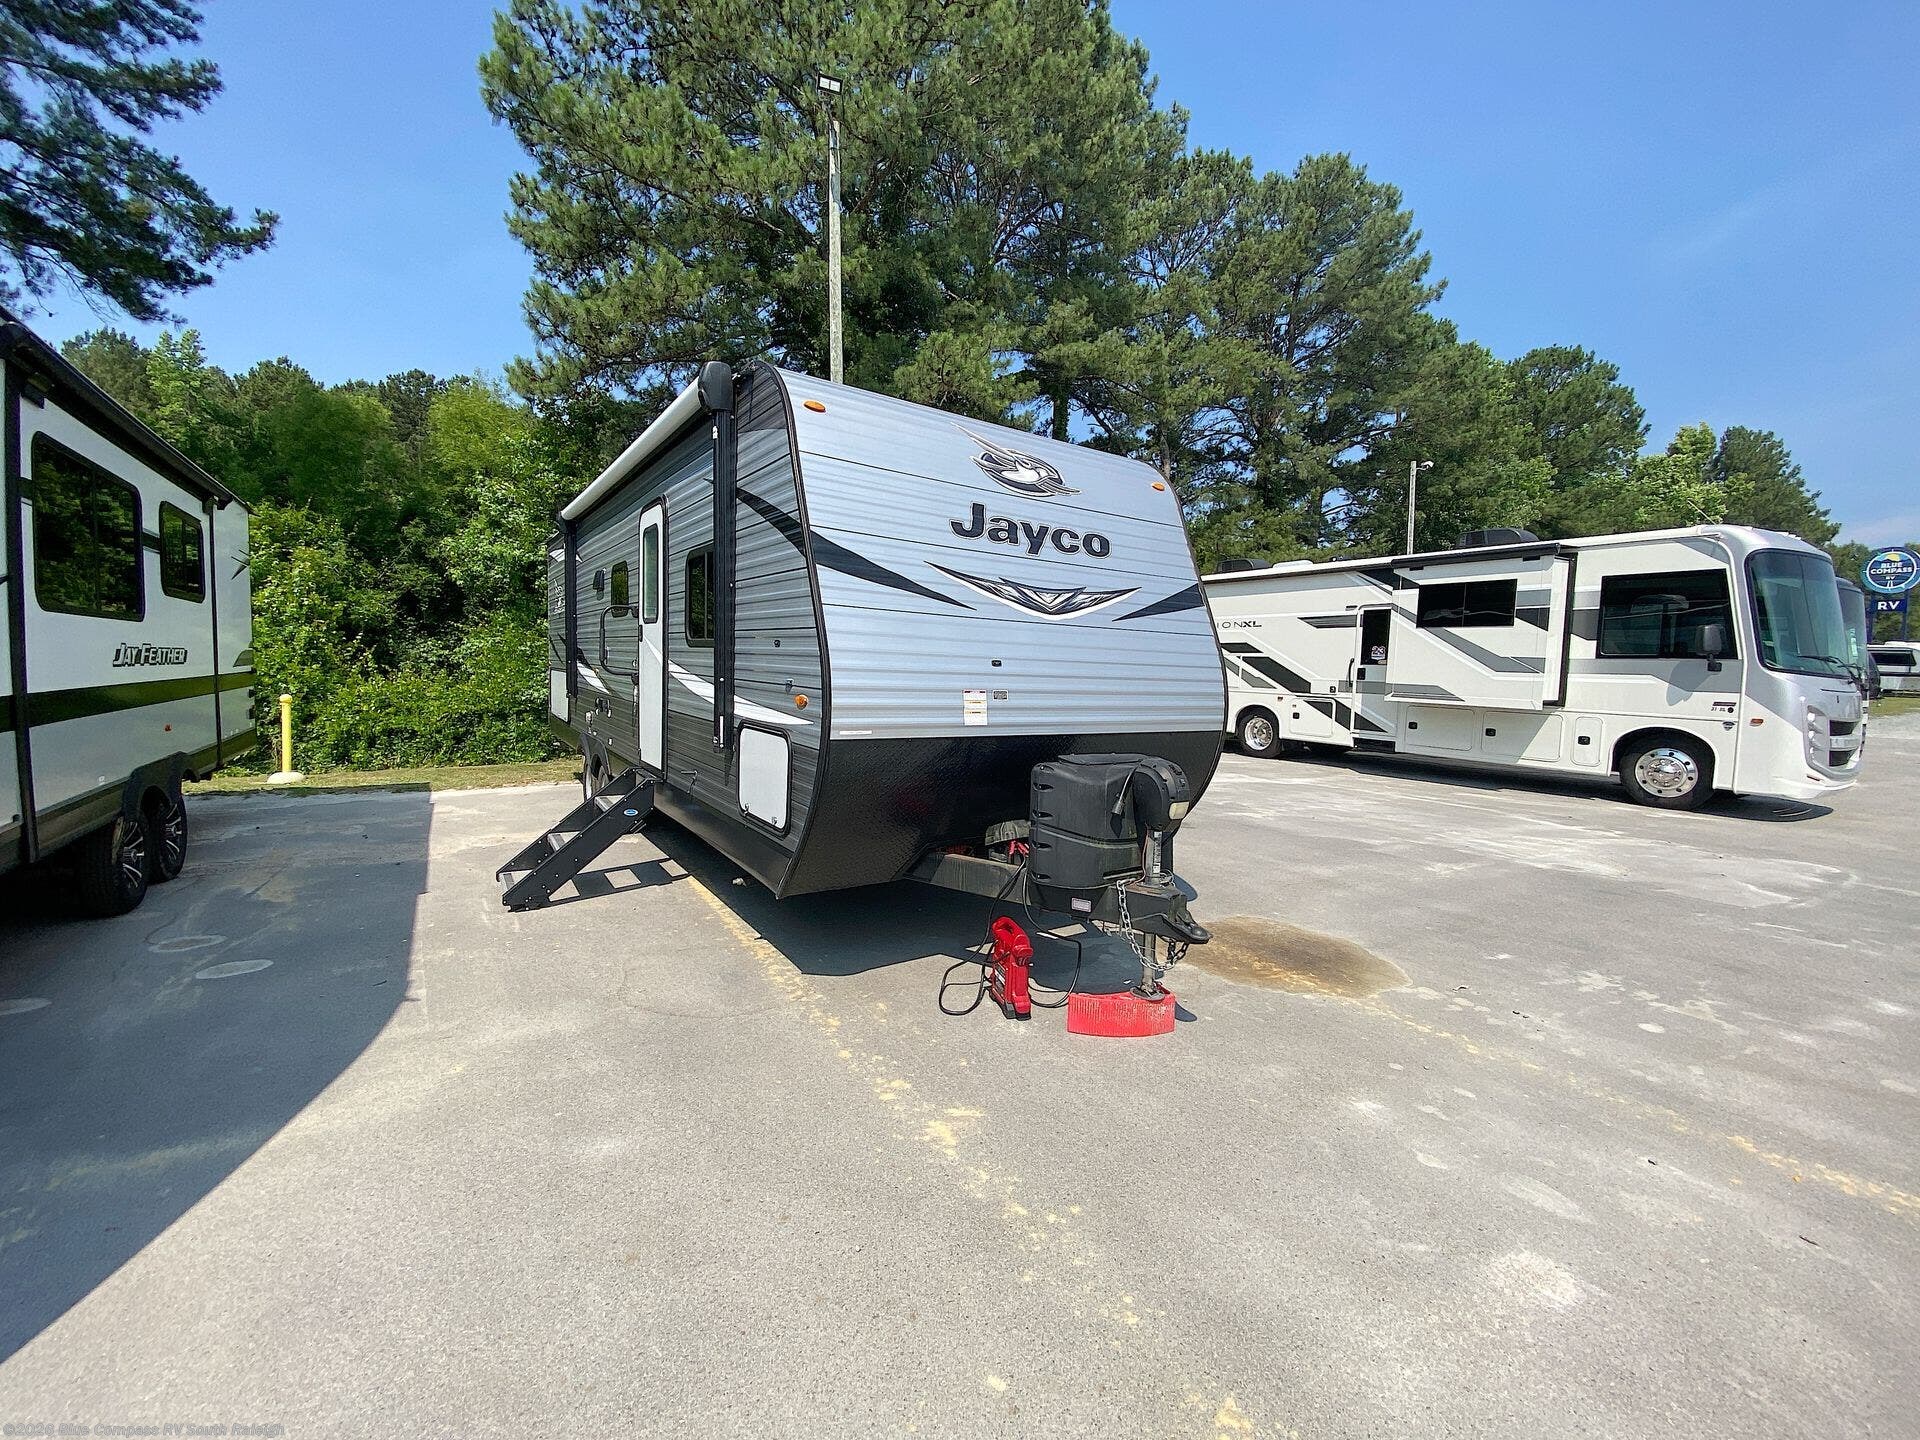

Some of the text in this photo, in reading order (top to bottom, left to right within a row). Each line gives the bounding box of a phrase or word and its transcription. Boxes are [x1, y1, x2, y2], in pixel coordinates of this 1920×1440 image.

[949, 502, 1111, 558] Jayco
[1870, 566, 1912, 575] COMPASS
[1877, 600, 1900, 610] RV
[112, 642, 187, 667] JAY FEATHER
